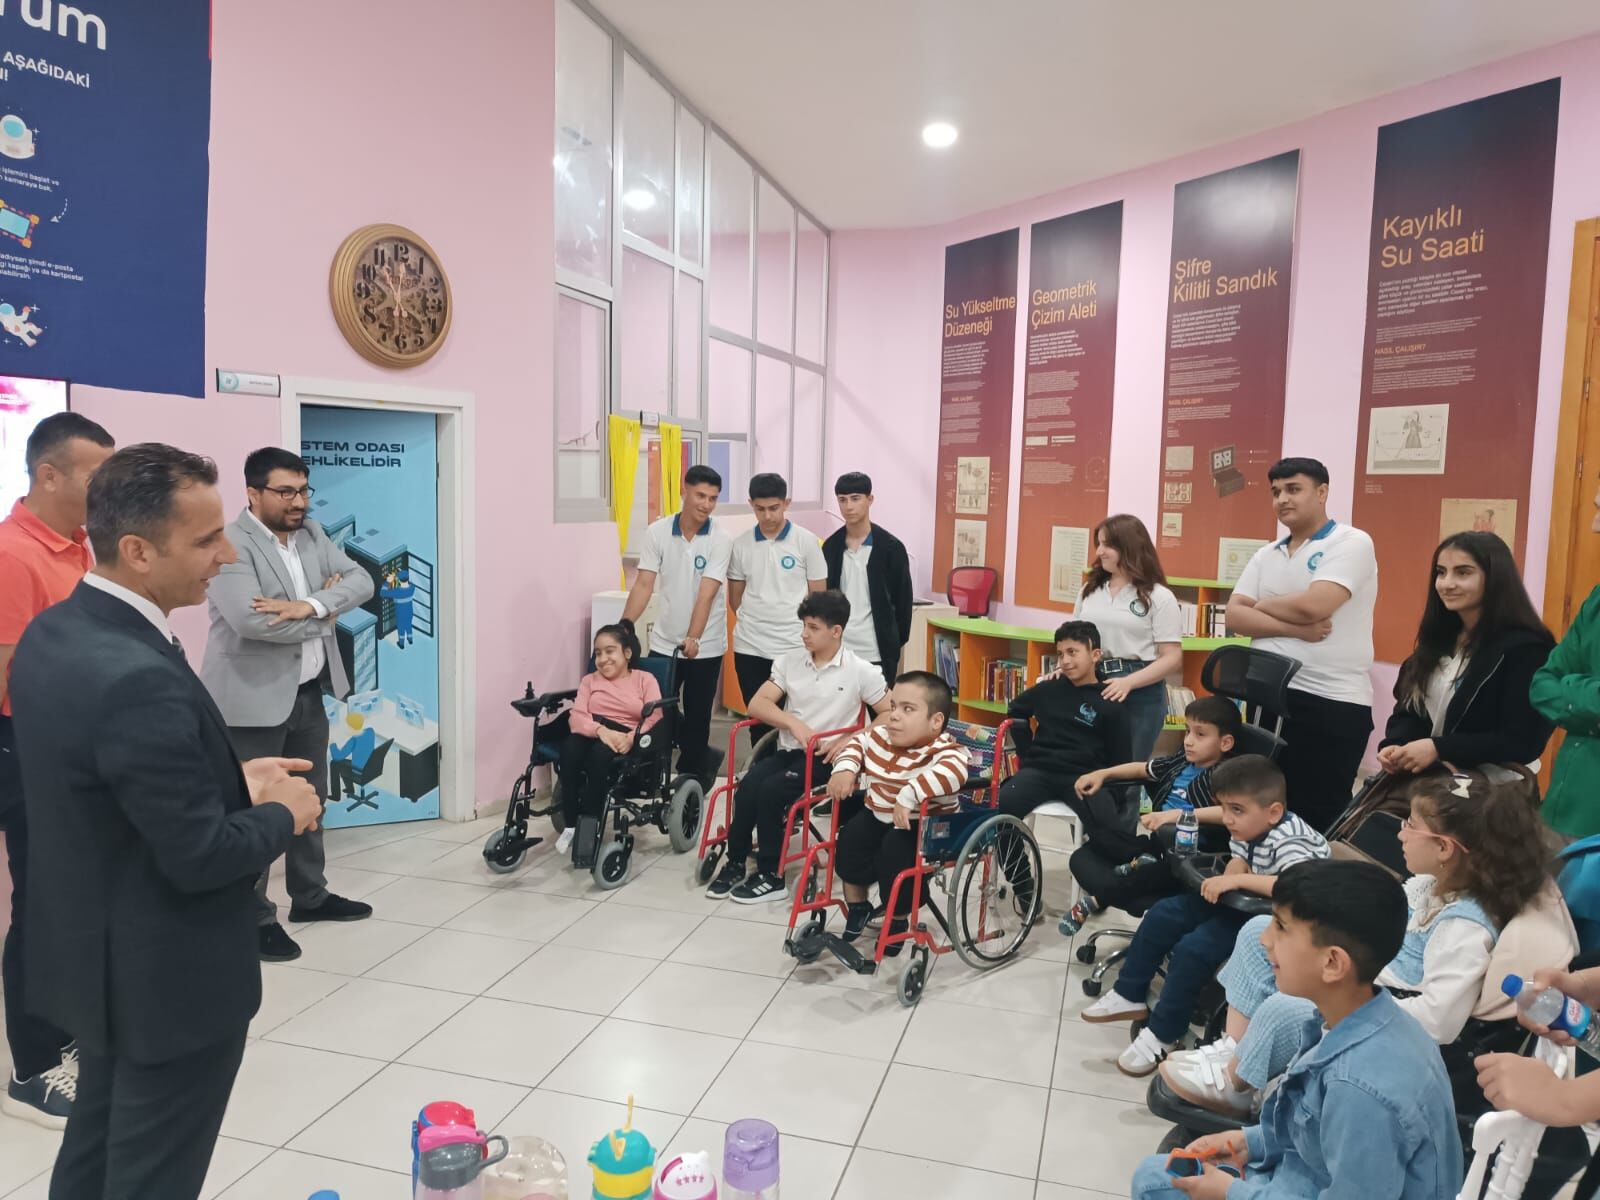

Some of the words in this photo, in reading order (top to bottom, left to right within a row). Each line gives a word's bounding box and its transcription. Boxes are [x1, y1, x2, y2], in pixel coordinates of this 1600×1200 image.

[3, 51, 90, 89] AŞAĞIDAKİ
[1383, 204, 1462, 240] Kayıklı
[1381, 245, 1412, 268] Su
[1421, 228, 1484, 262] Saati
[1174, 257, 1212, 284] Şifre
[1032, 279, 1097, 306] Geometrik
[1173, 279, 1211, 304] Kilitli
[1215, 266, 1278, 297] Sandık
[945, 304, 959, 320] Su
[962, 295, 1016, 317] Yükseltme
[1031, 308, 1065, 330] Çizim
[1068, 300, 1097, 321] Aleti
[945, 316, 993, 338] Düzeneği
[355, 442, 405, 454] ODASI
